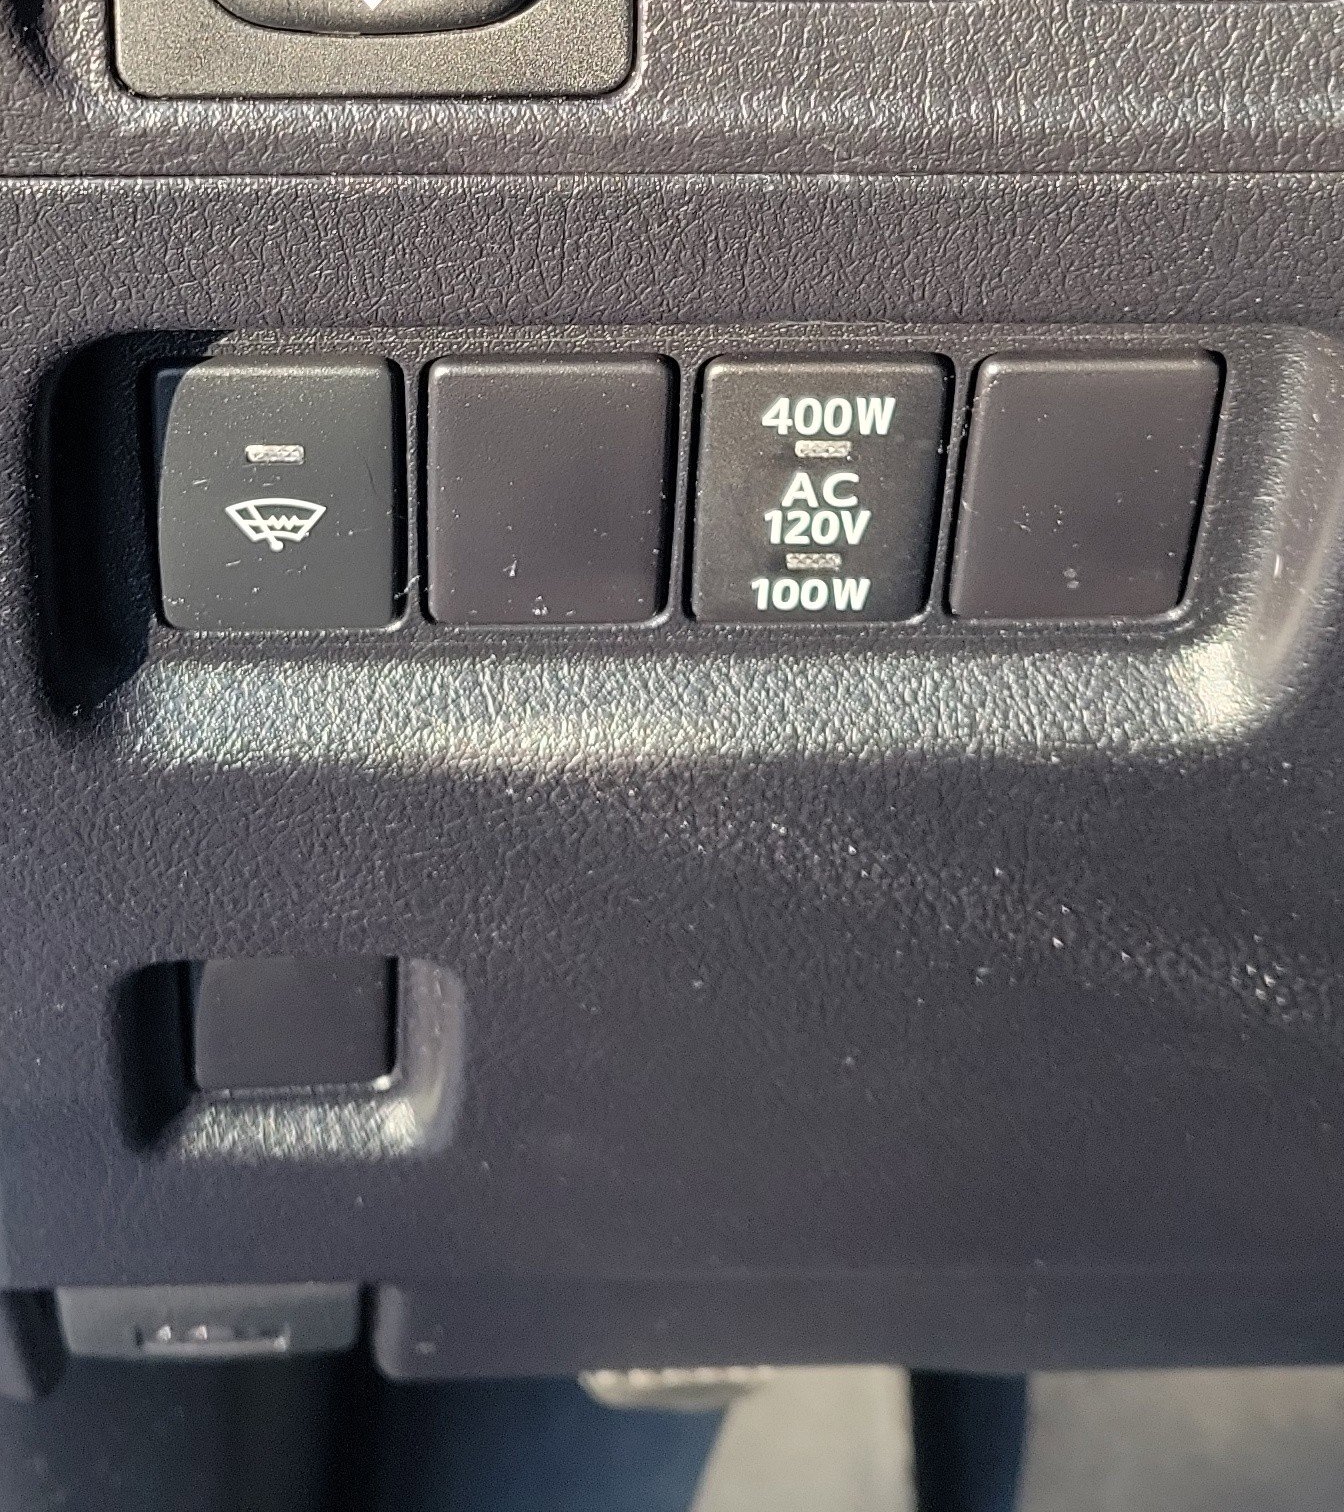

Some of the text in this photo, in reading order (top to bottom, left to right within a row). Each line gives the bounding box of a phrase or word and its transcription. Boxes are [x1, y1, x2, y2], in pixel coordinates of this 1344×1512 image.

[761, 396, 897, 436] 400W
[780, 471, 861, 509] AC
[763, 509, 872, 546] 120V
[750, 577, 872, 611] 100W
